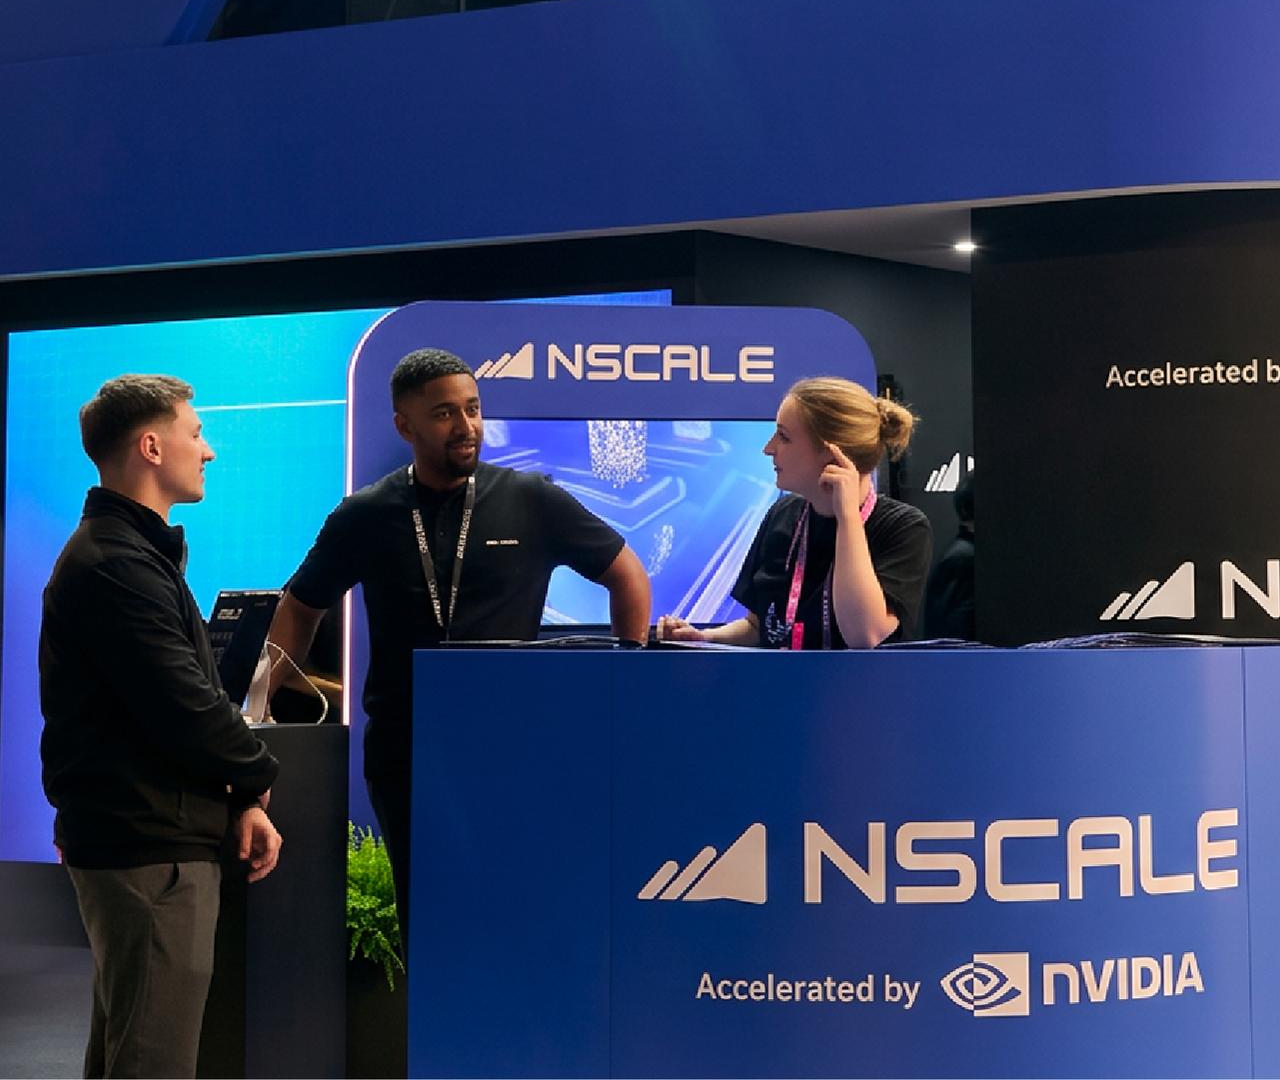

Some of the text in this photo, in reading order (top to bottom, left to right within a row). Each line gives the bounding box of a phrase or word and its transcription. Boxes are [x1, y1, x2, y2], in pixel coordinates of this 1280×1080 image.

[547, 343, 775, 383] NSCALE
[1105, 358, 1258, 388] Accelerated
[804, 808, 1239, 904] NSCALE
[696, 972, 874, 1002] Accelerated
[885, 974, 921, 1009] by
